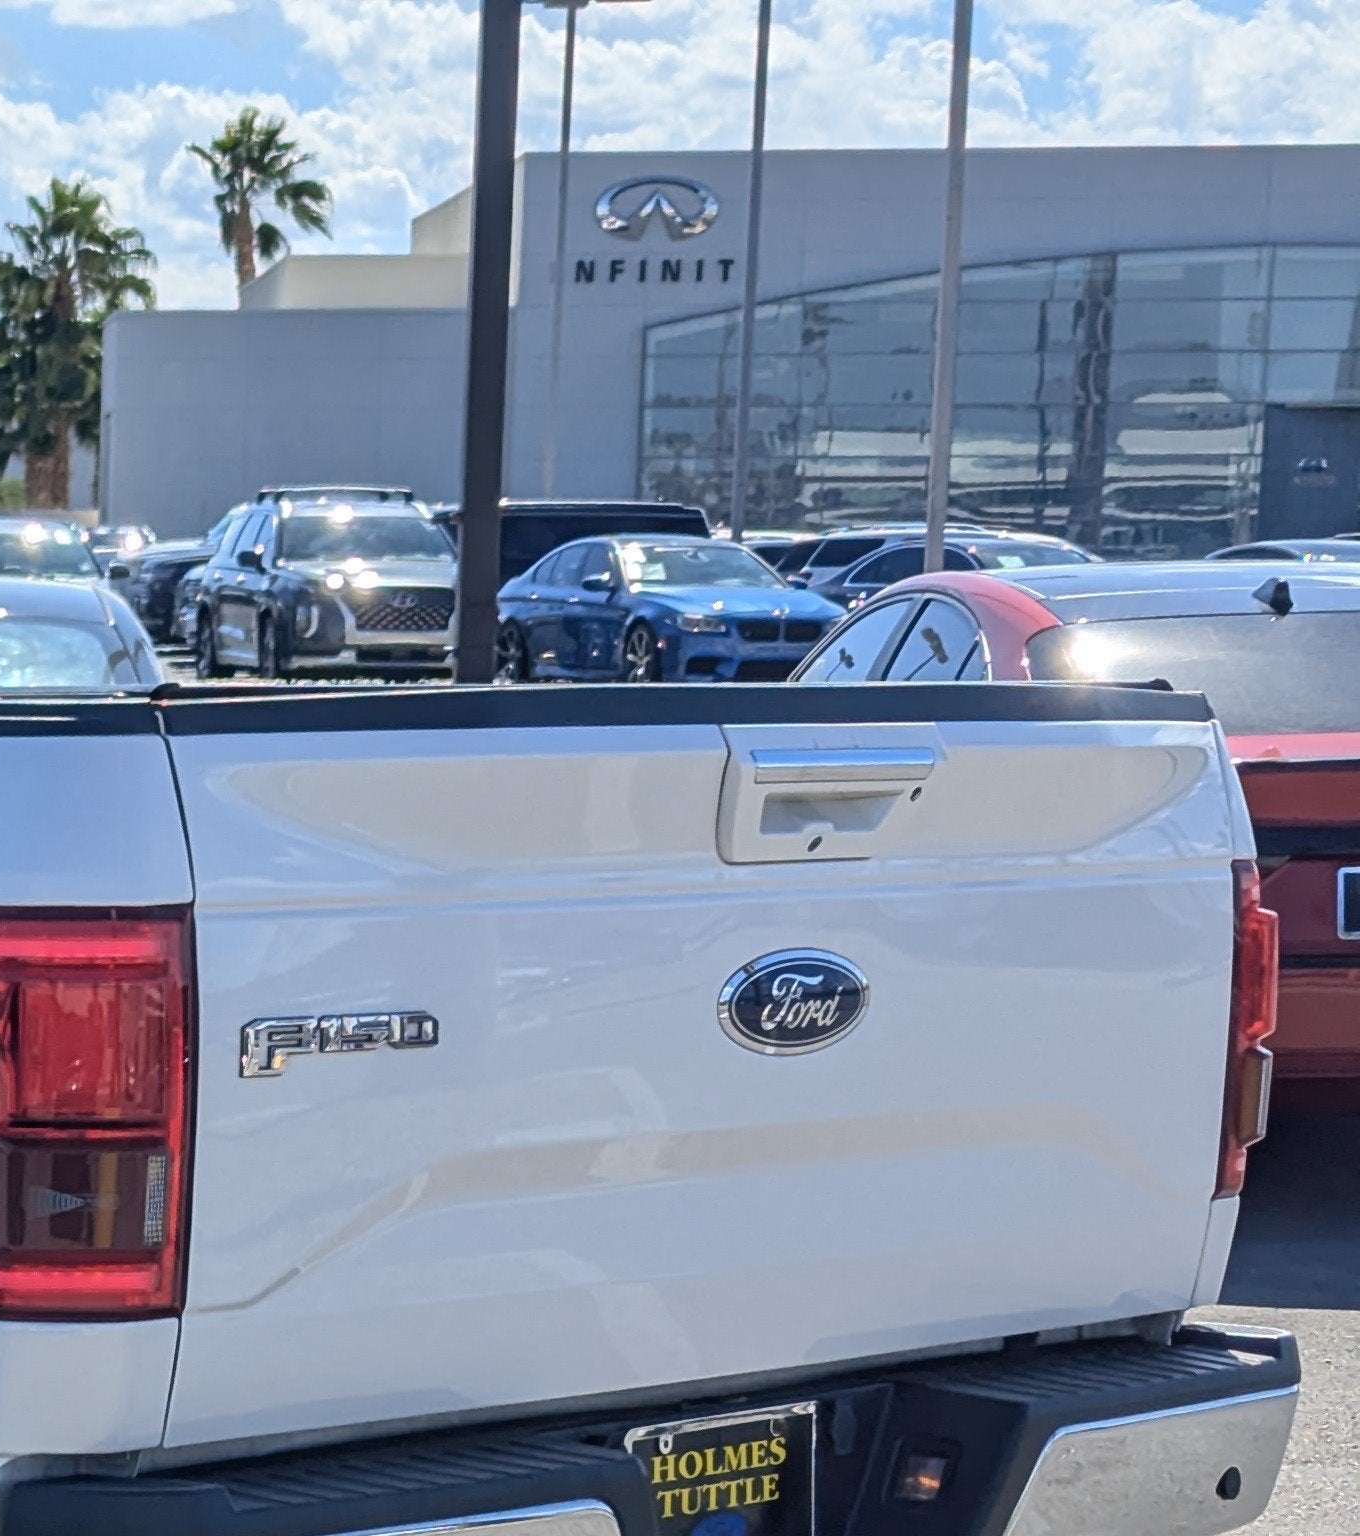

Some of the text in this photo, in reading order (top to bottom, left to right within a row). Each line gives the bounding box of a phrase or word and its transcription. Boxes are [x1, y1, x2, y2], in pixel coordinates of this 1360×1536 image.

[573, 257, 736, 284] NFINIT
[760, 973, 843, 1031] Ford
[651, 1436, 787, 1484] HOLMES
[656, 1473, 780, 1519] TUTTLE
